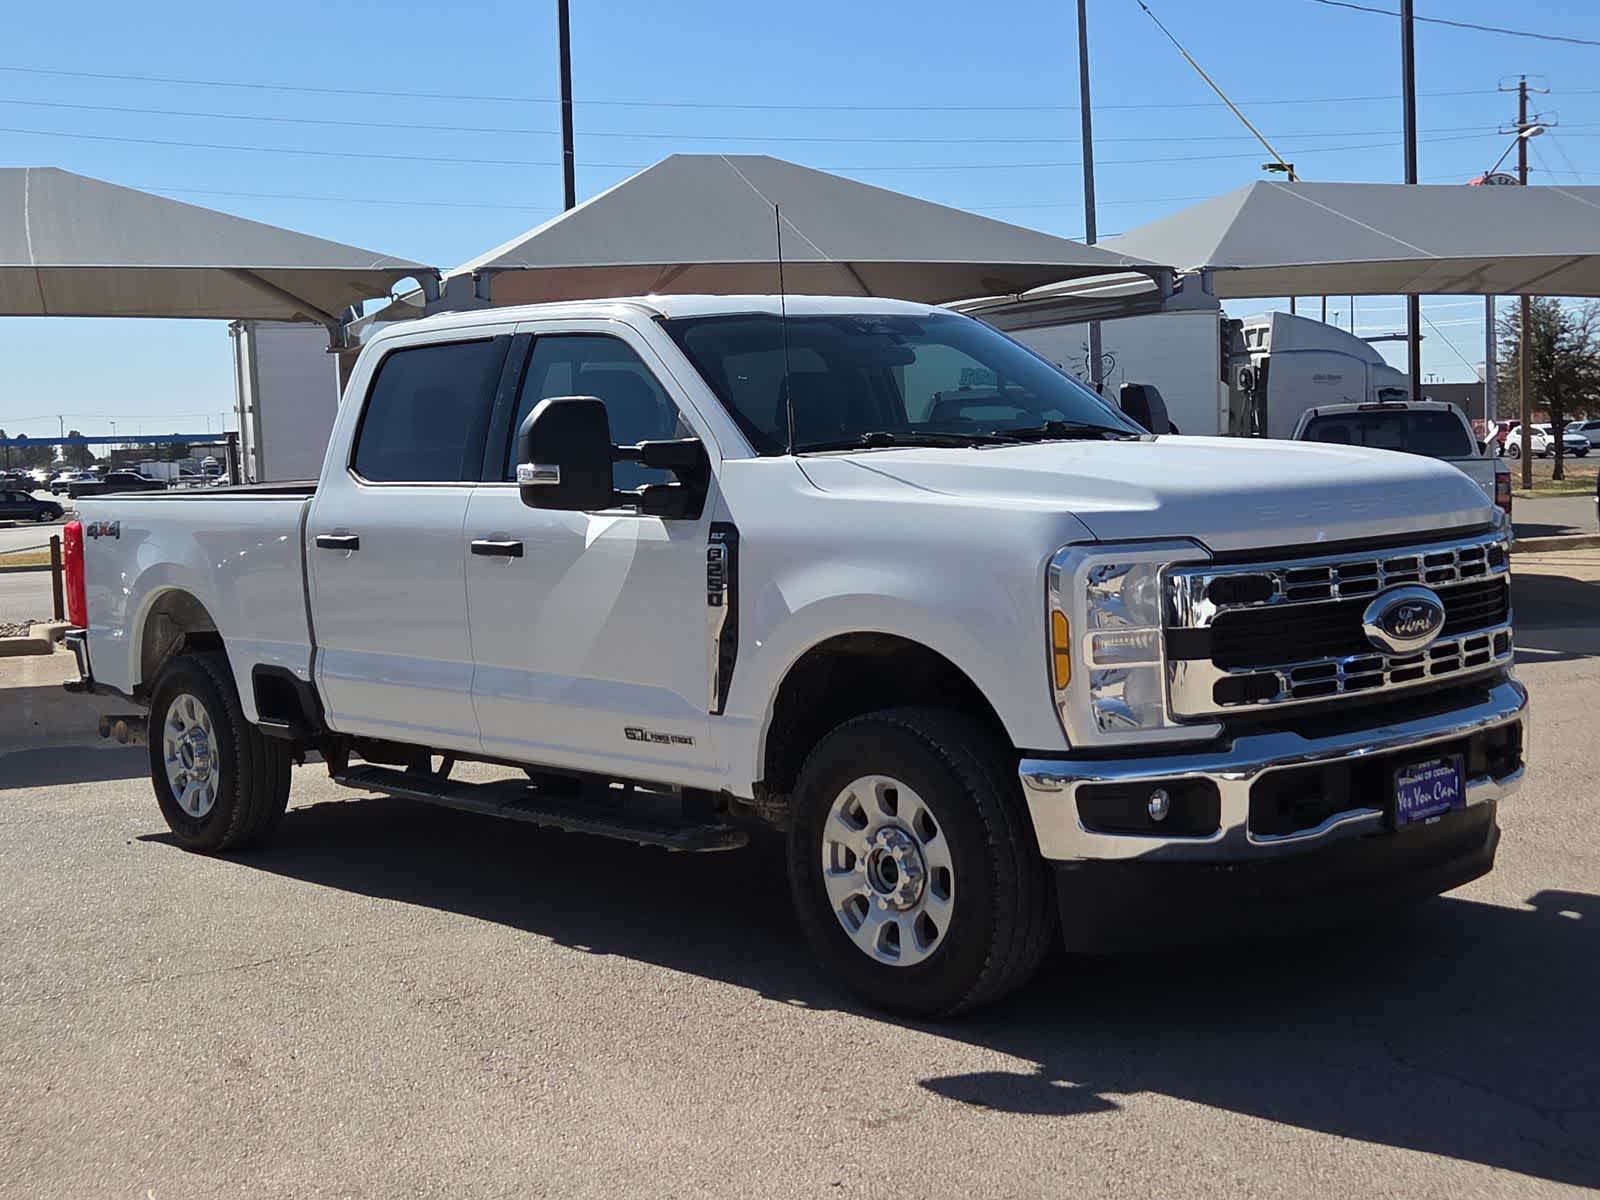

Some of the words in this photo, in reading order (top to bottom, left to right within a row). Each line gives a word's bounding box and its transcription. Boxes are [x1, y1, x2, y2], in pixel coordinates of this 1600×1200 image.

[1395, 606, 1432, 634] Ford
[1397, 791, 1412, 811] Yes
[1413, 786, 1432, 806] You
[1433, 775, 1459, 801] Can!
